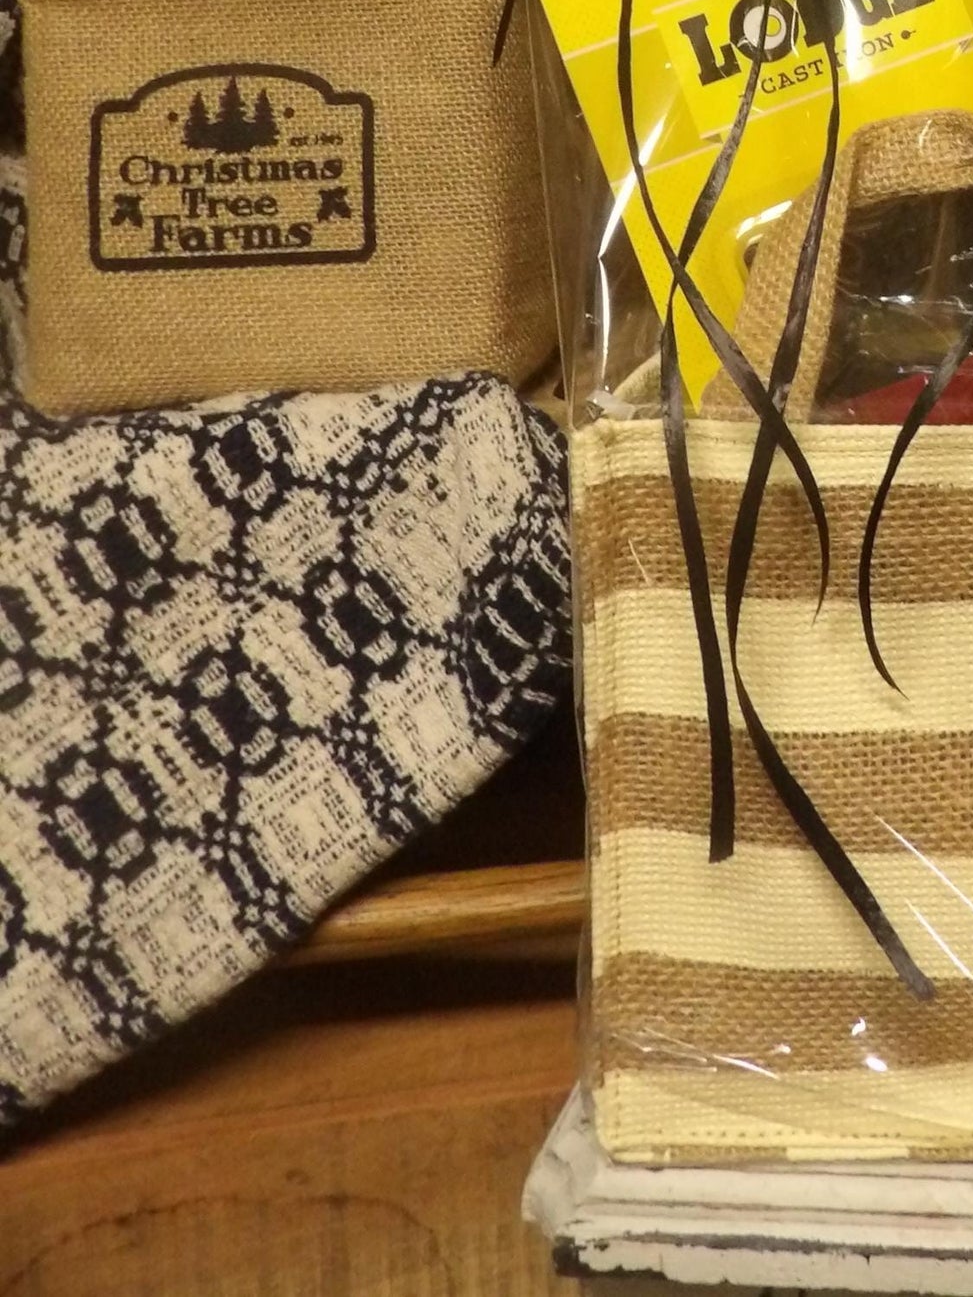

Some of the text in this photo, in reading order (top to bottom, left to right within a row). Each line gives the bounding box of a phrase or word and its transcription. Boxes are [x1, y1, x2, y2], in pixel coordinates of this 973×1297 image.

[761, 32, 895, 95] CAST ION
[120, 156, 343, 184] Christmas
[181, 188, 278, 218] Tree
[152, 215, 313, 251] Farms
